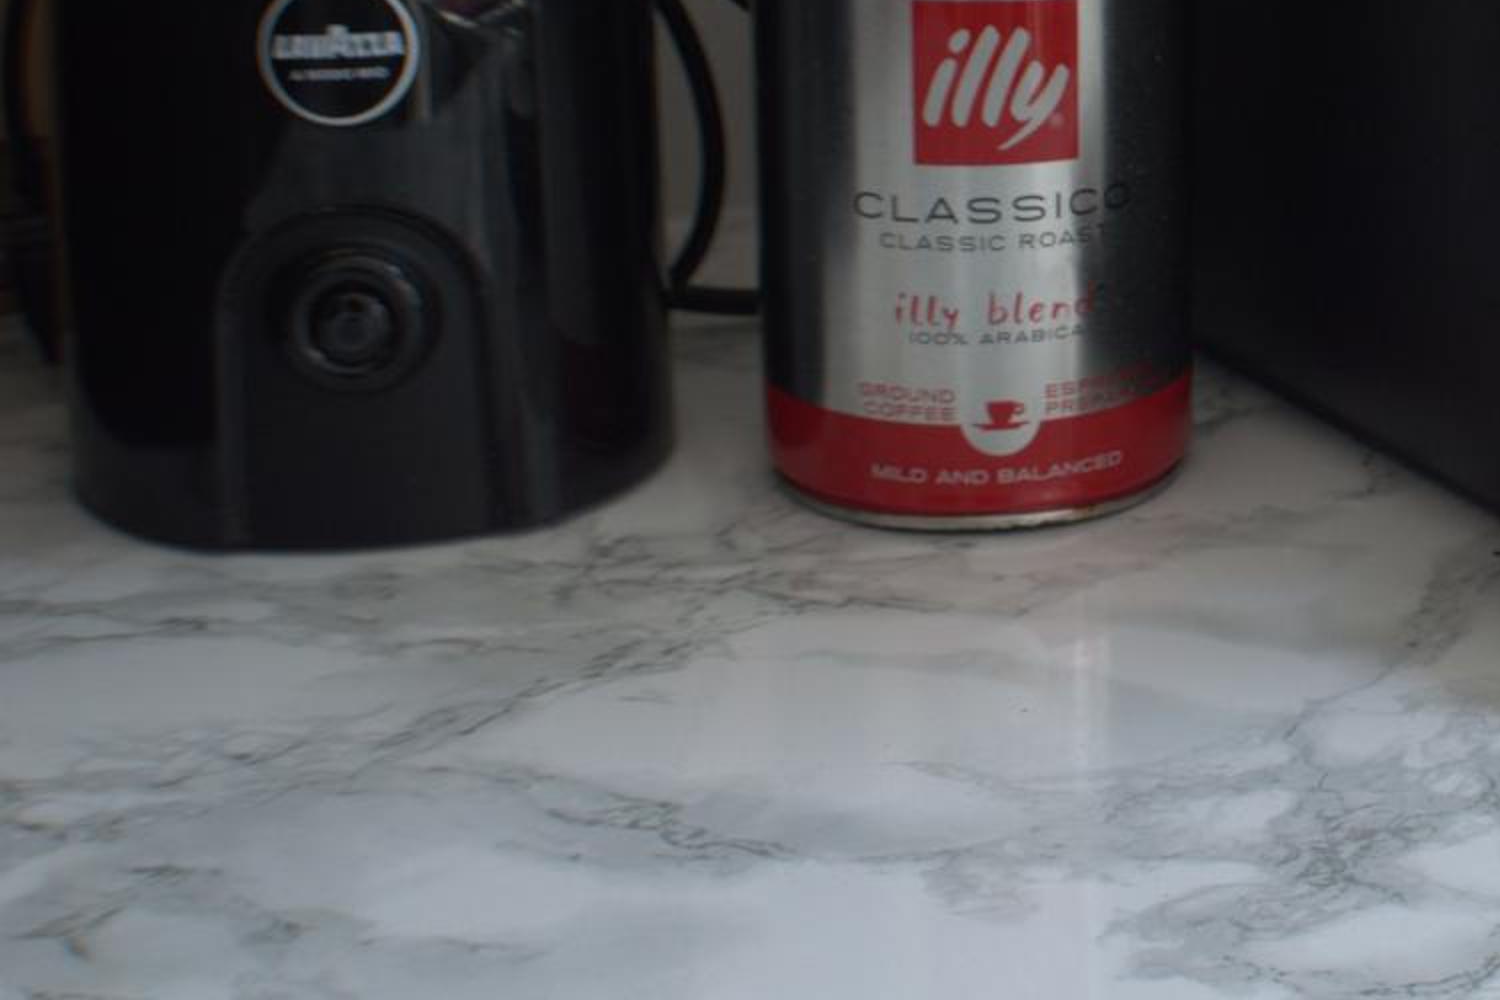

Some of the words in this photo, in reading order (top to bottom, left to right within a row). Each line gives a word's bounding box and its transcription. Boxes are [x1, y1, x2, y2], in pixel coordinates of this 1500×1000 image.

[922, 23, 1071, 151] illy
[852, 183, 1133, 225] CLASSICO
[878, 232, 1007, 252] CLASSIC
[894, 292, 960, 328] illy
[986, 278, 1098, 326] blend
[935, 467, 989, 486] AND
[996, 450, 1123, 484] BALANCED
